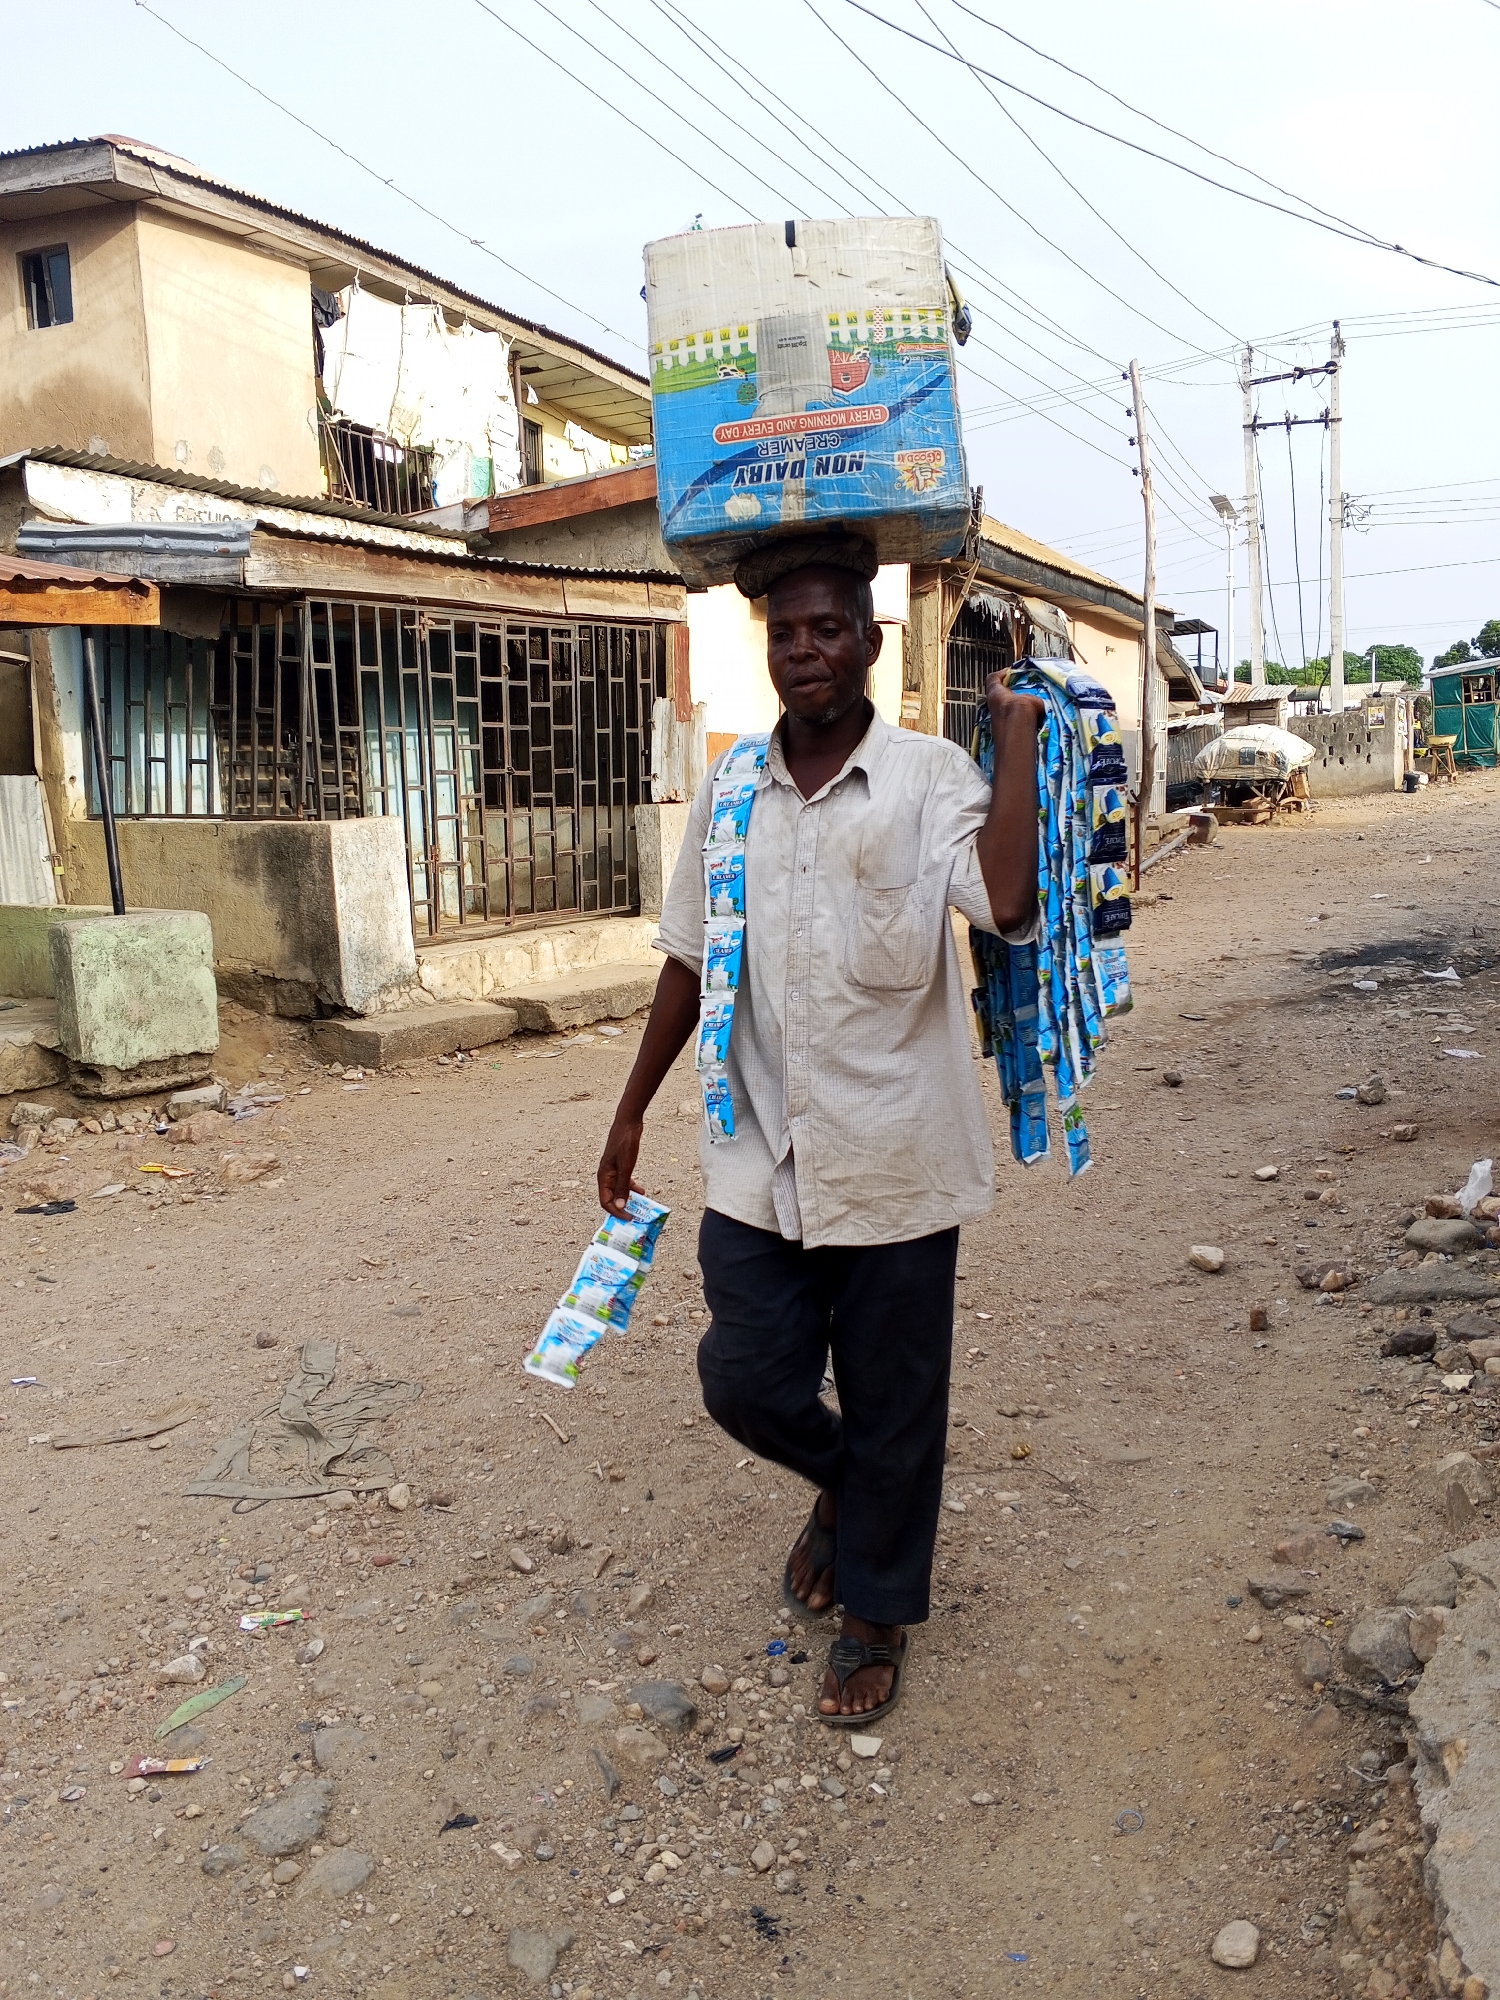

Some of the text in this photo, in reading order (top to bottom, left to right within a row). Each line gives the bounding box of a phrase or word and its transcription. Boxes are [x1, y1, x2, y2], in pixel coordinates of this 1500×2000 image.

[720, 408, 882, 440] EVERY MORNING AND EVERY DAY
[757, 433, 842, 457] CREAMER
[733, 450, 866, 488] NON DAIRY
